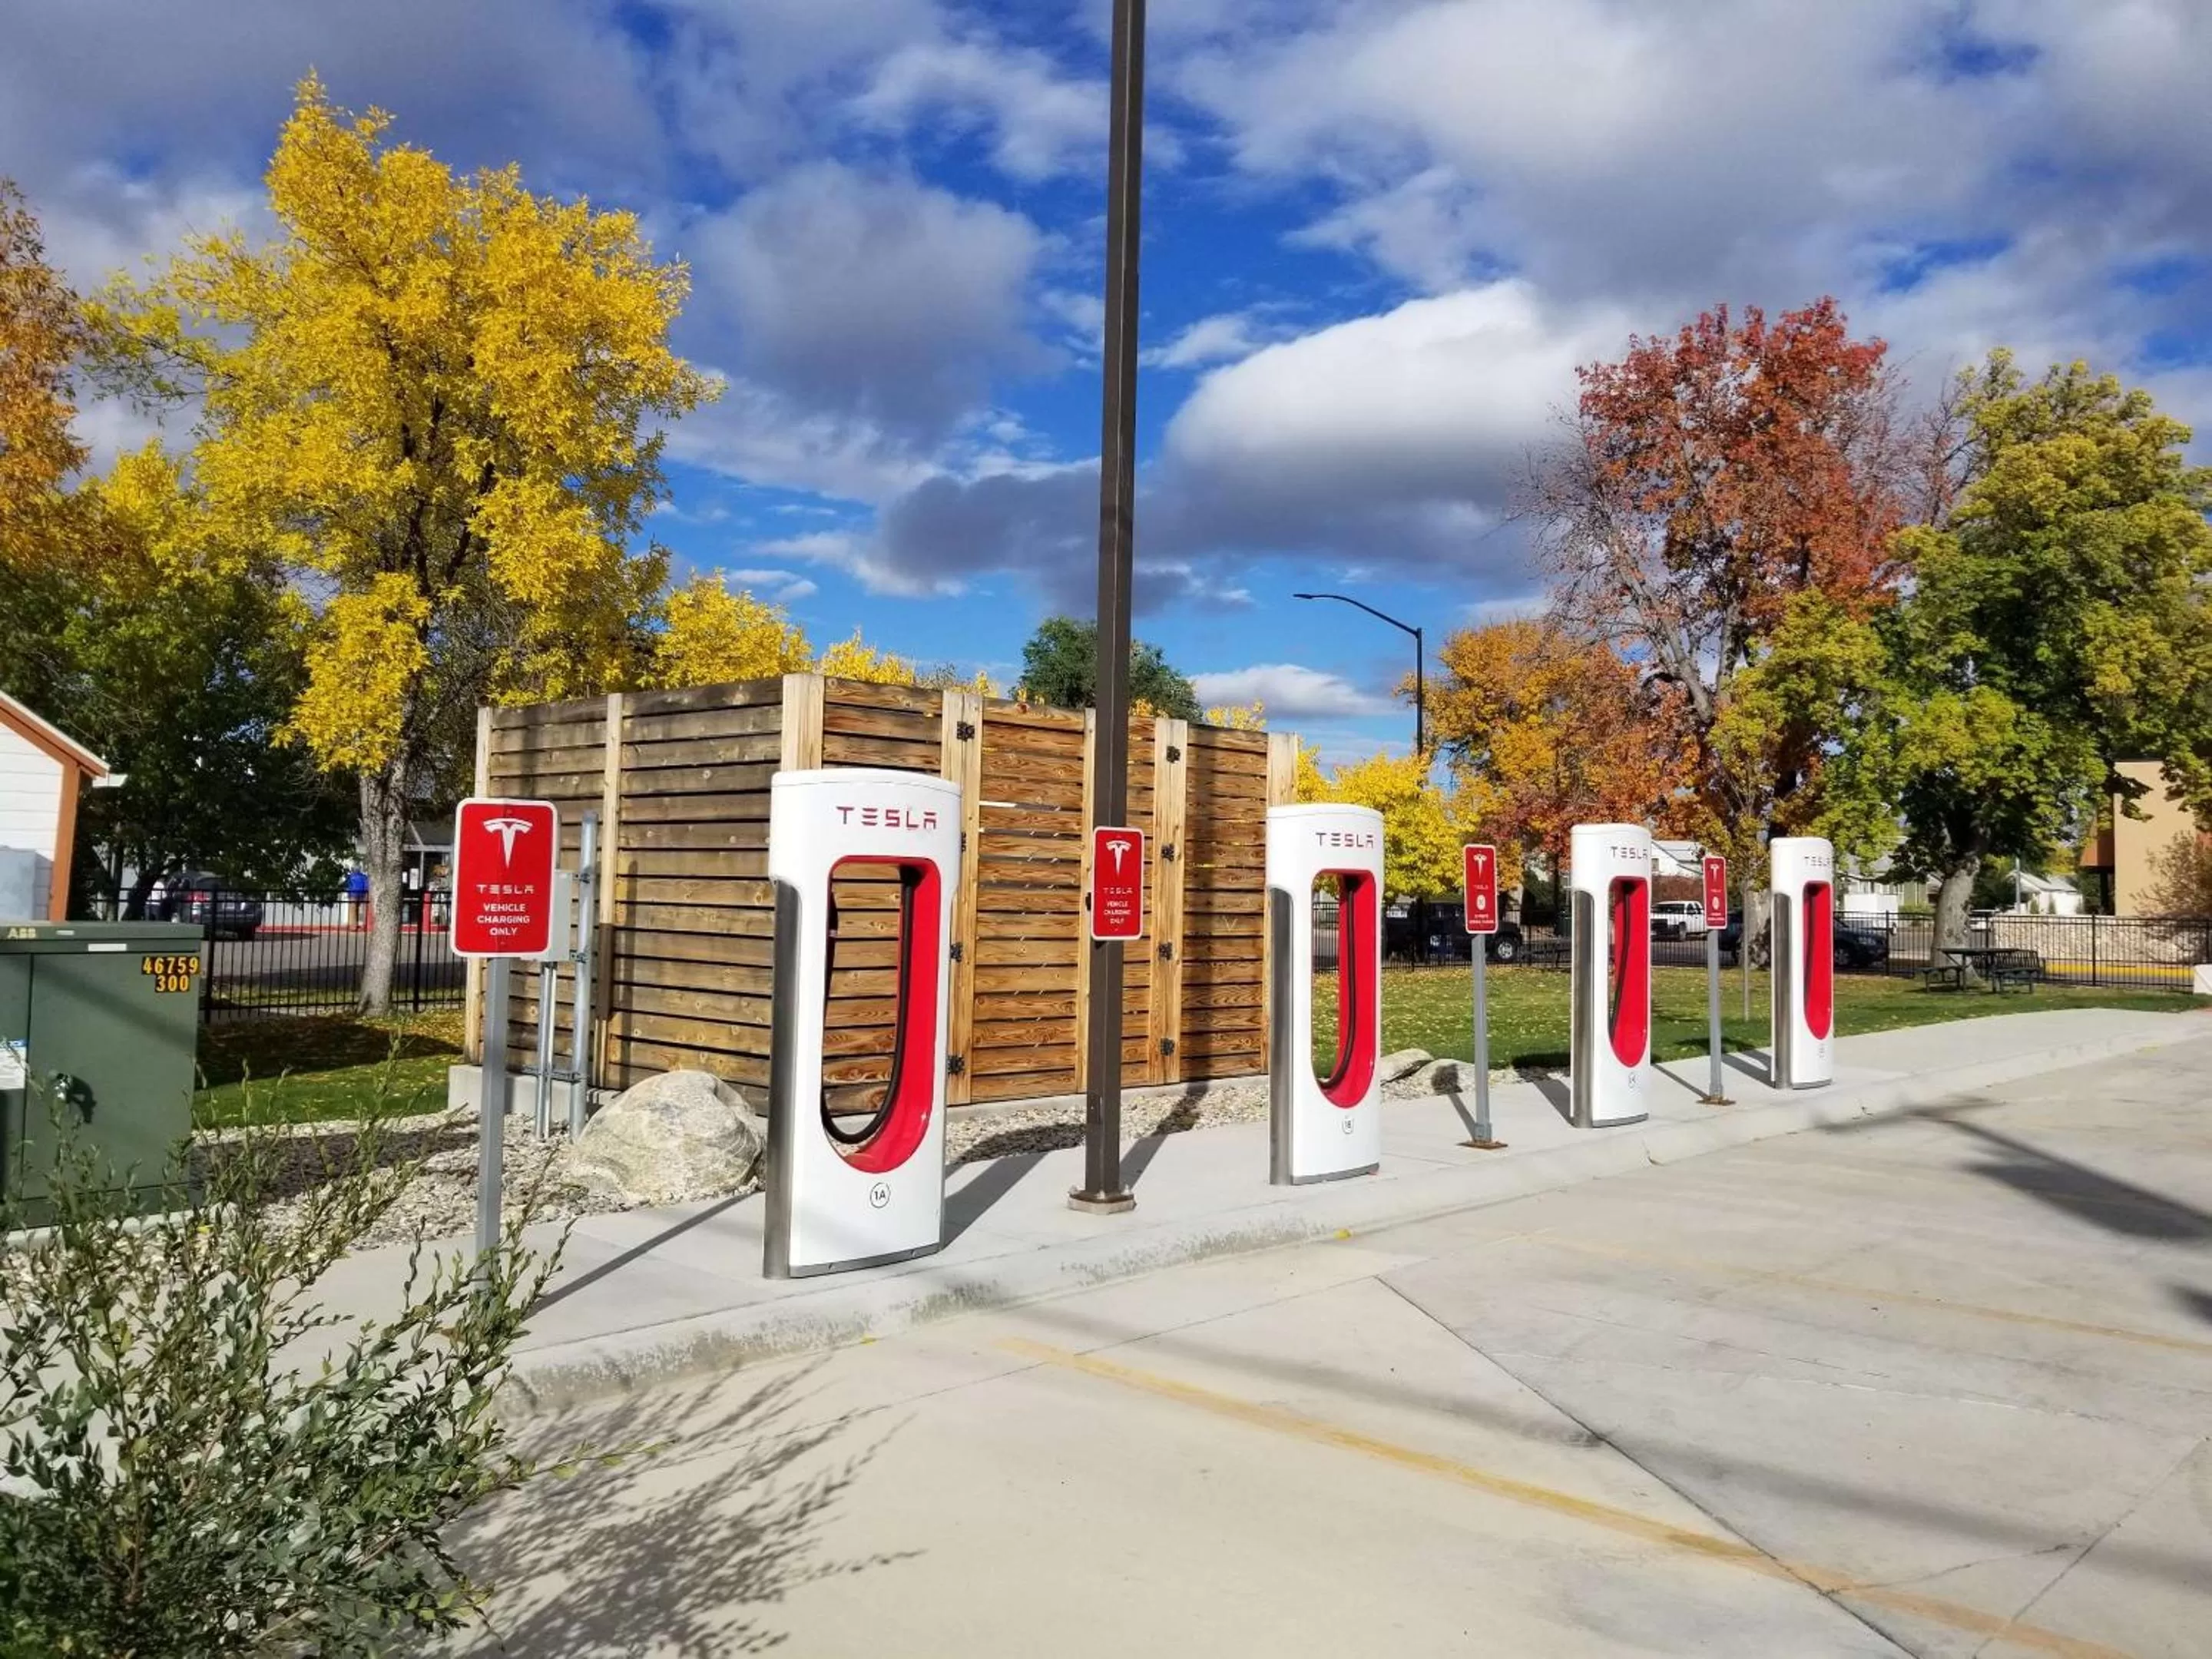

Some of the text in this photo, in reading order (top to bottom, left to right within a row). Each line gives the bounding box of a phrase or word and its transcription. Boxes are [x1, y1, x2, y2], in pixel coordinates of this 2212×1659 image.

[836, 806, 937, 830] TESLA
[1316, 832, 1373, 849] TESLA
[1610, 846, 1647, 859] TESLA
[475, 884, 535, 895] TESLA
[1102, 886, 1133, 895] TESLA
[483, 903, 526, 912] VEHICLE
[476, 915, 530, 924] CHARGING
[7, 926, 37, 939] ABB
[489, 927, 518, 936] ONLY
[143, 956, 198, 974] 46759
[156, 975, 189, 992] 300
[874, 1189, 886, 1200] 1A
